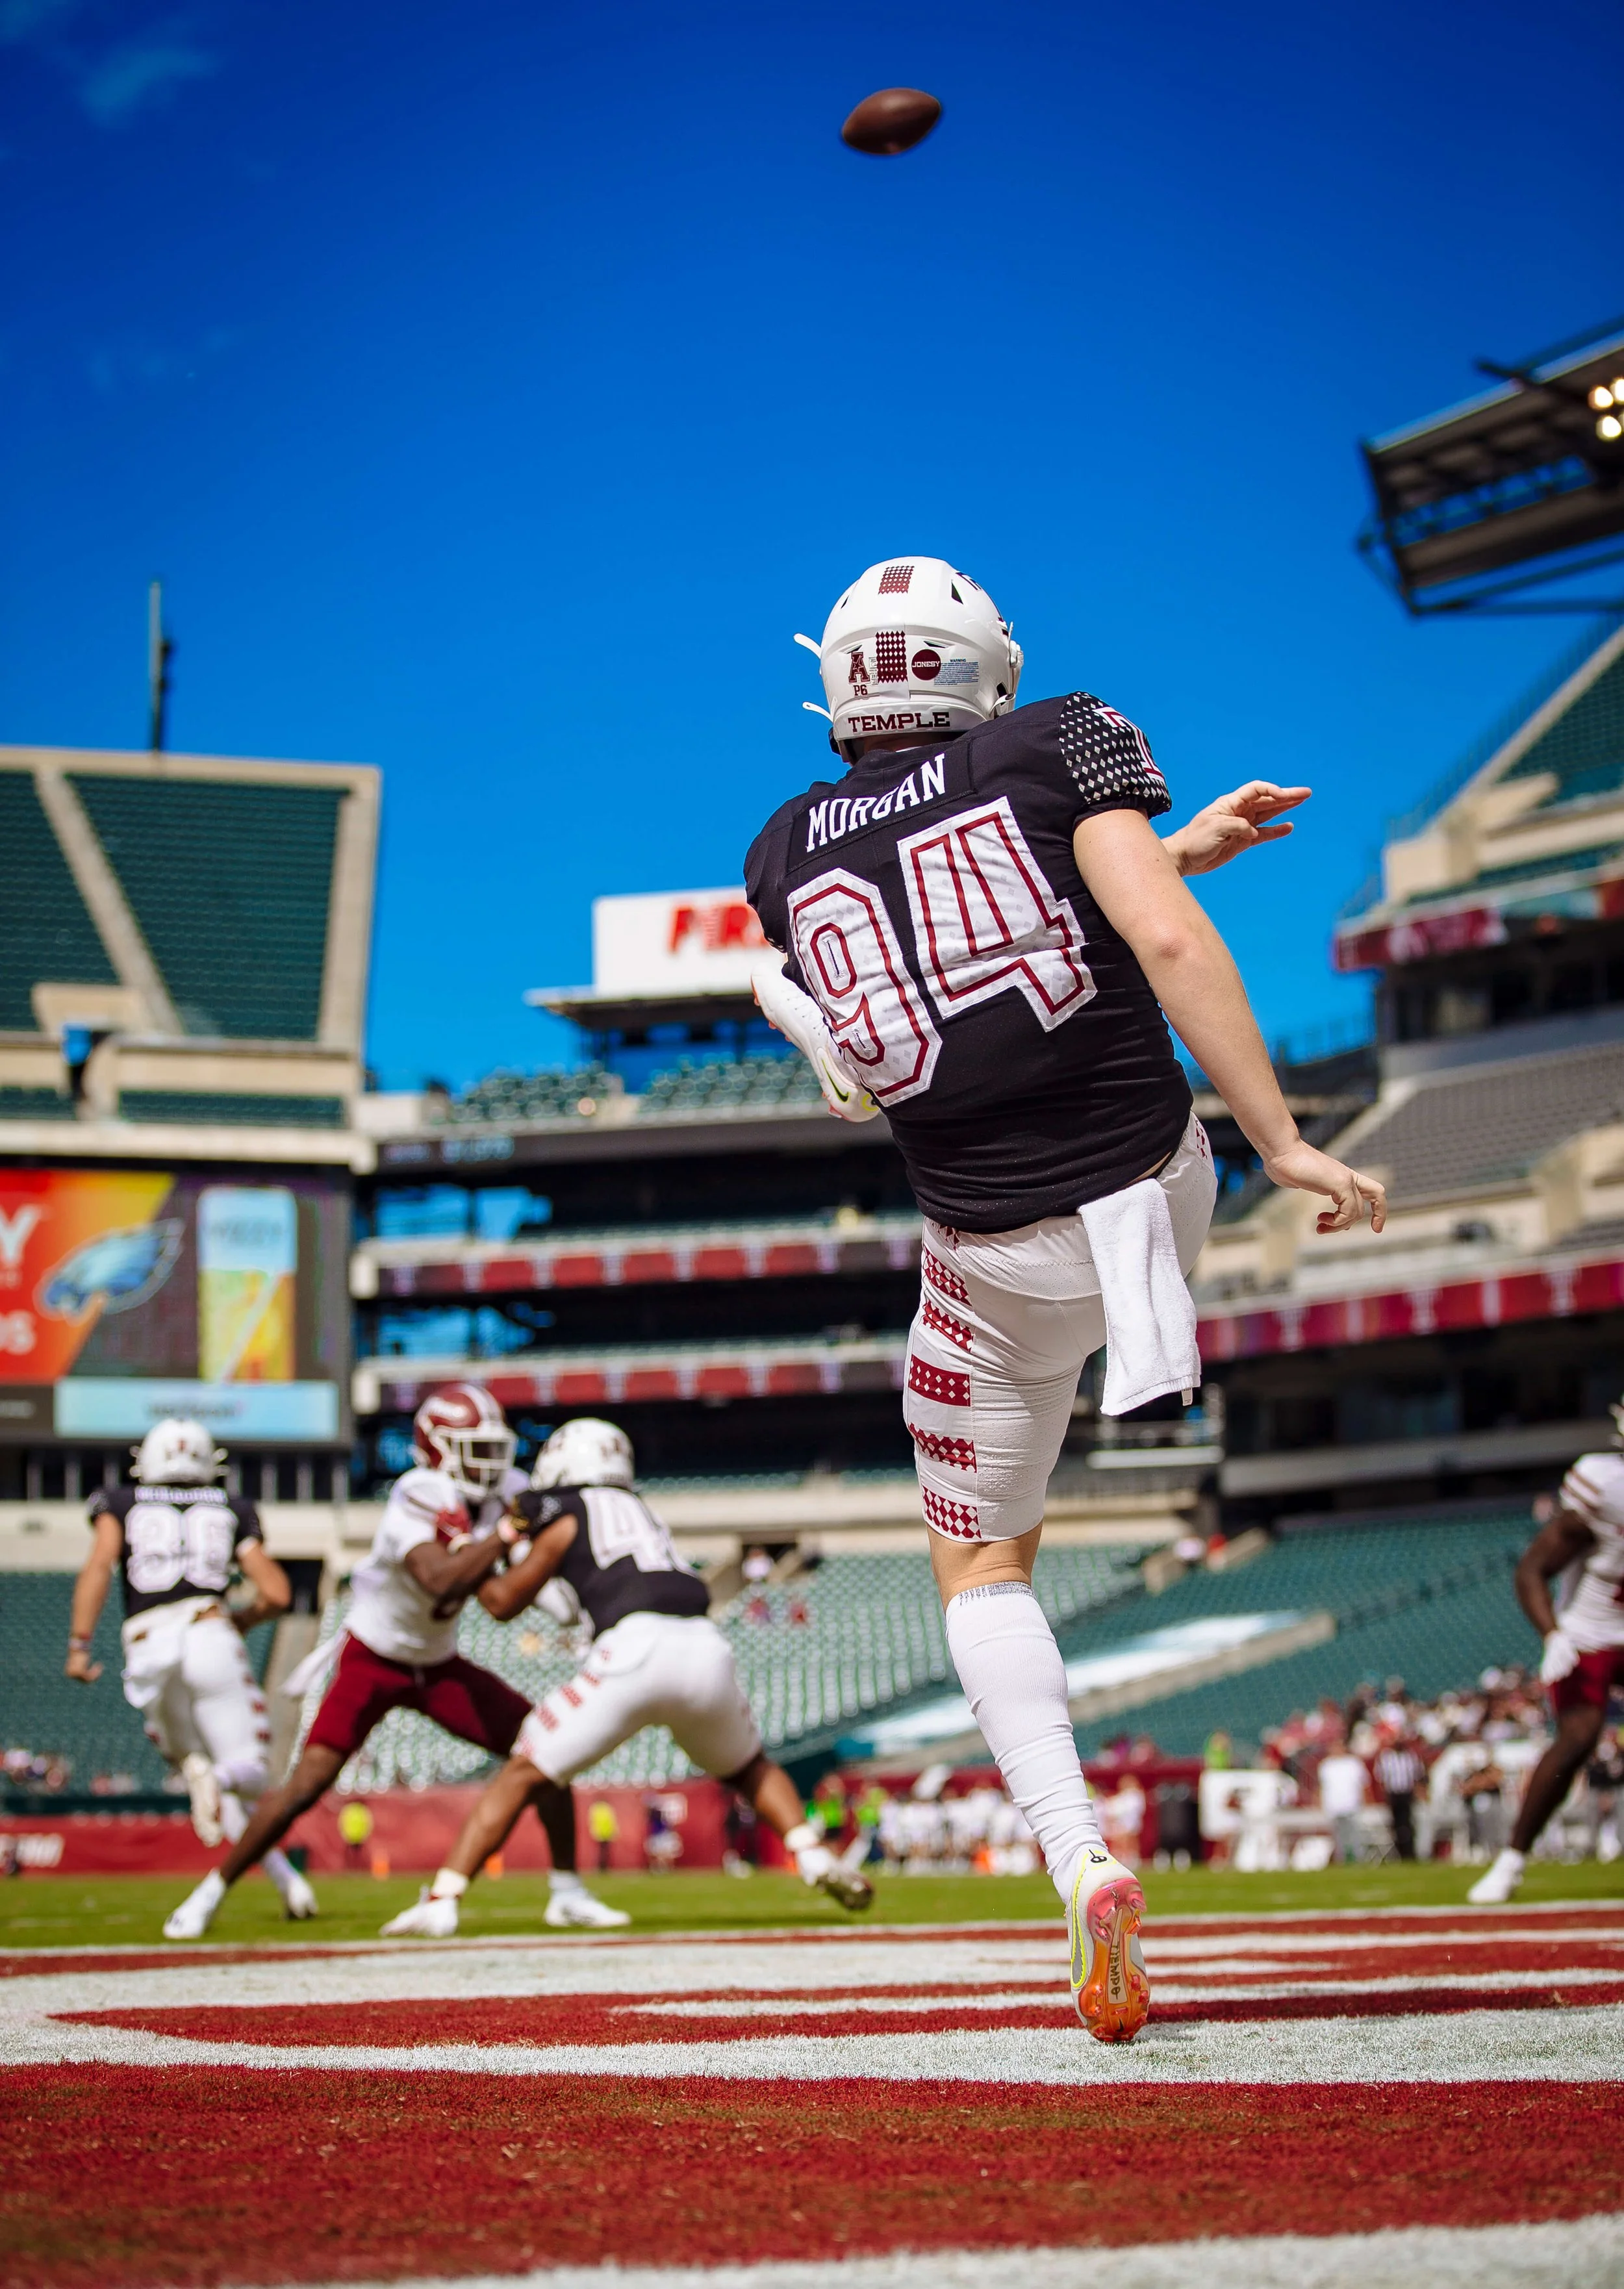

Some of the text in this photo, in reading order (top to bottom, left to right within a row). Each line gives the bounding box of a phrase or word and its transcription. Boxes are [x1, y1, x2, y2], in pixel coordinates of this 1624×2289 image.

[853, 684, 868, 696] P6
[848, 711, 951, 733] TEMPLE
[805, 753, 946, 852] MORGAN
[787, 795, 1097, 1107] 94
[1111, 1940, 1121, 2000] TIEMPO
